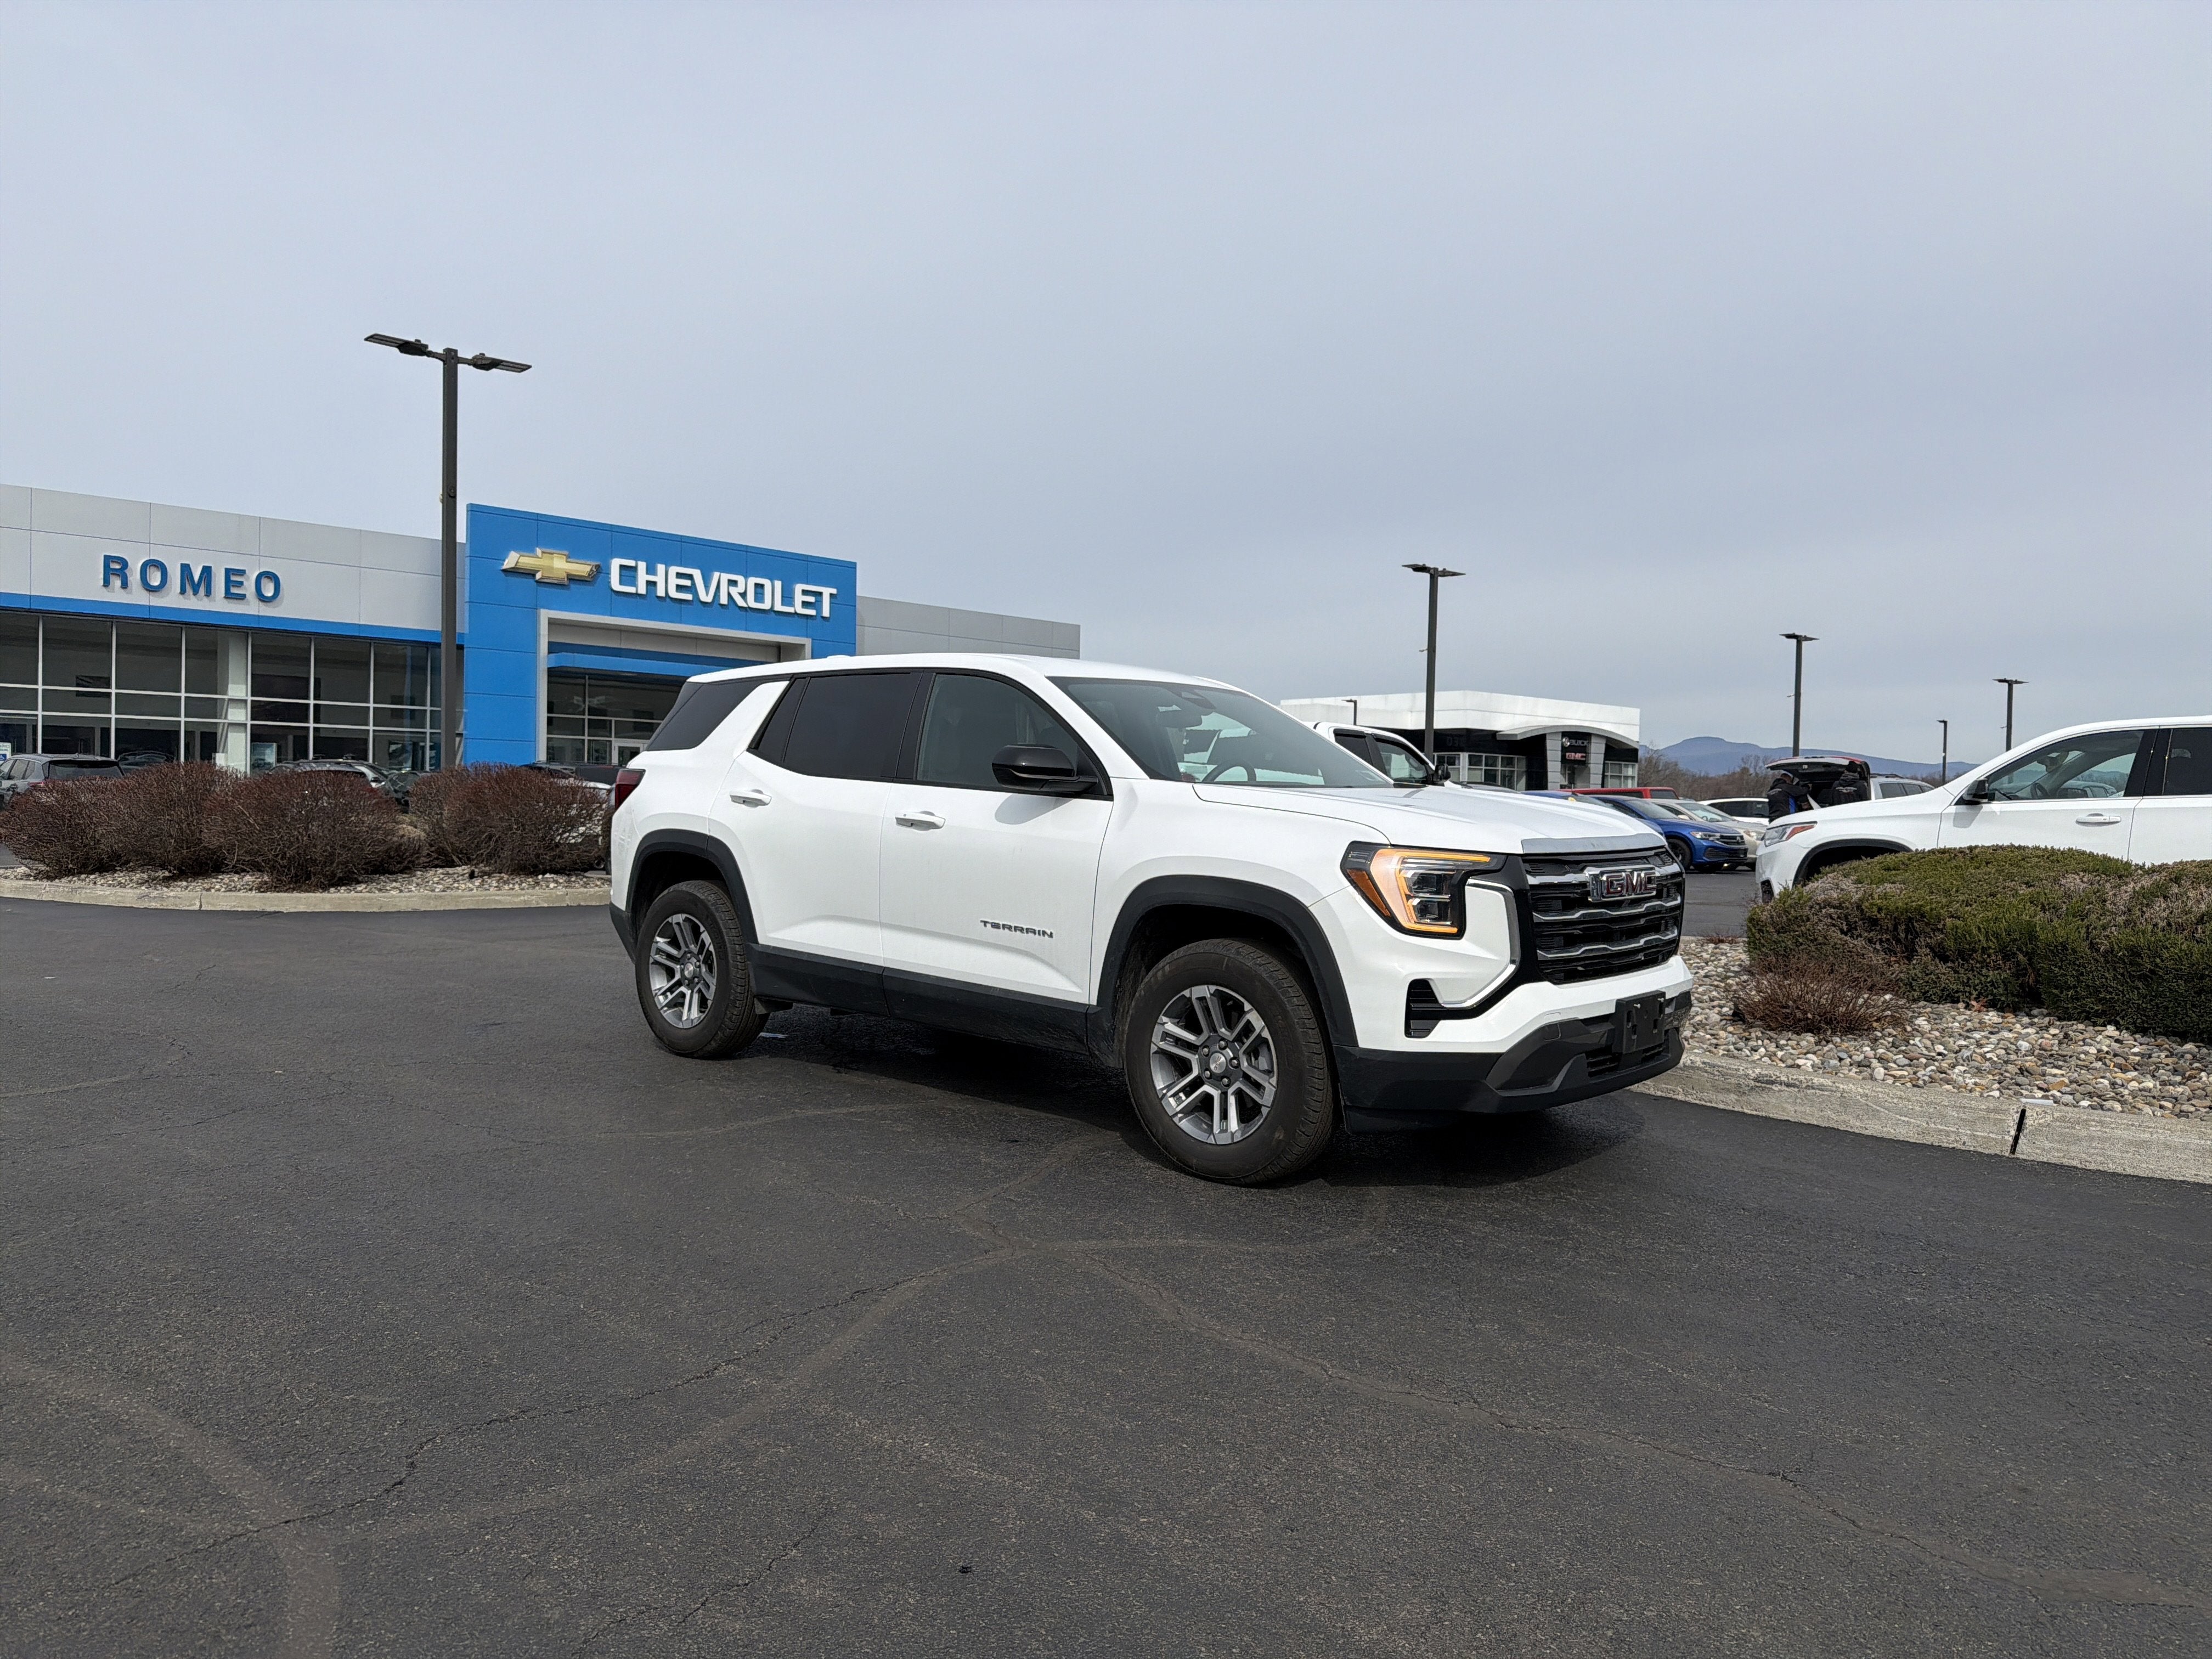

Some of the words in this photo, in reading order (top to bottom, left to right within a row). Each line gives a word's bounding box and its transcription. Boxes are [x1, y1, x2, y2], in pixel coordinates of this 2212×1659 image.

[102, 554, 281, 602] ROMEO
[610, 557, 837, 618] CHEVROLET
[1566, 752, 1586, 760] GMC
[1602, 870, 1657, 897] GMC
[980, 919, 1054, 939] TERRAIN
